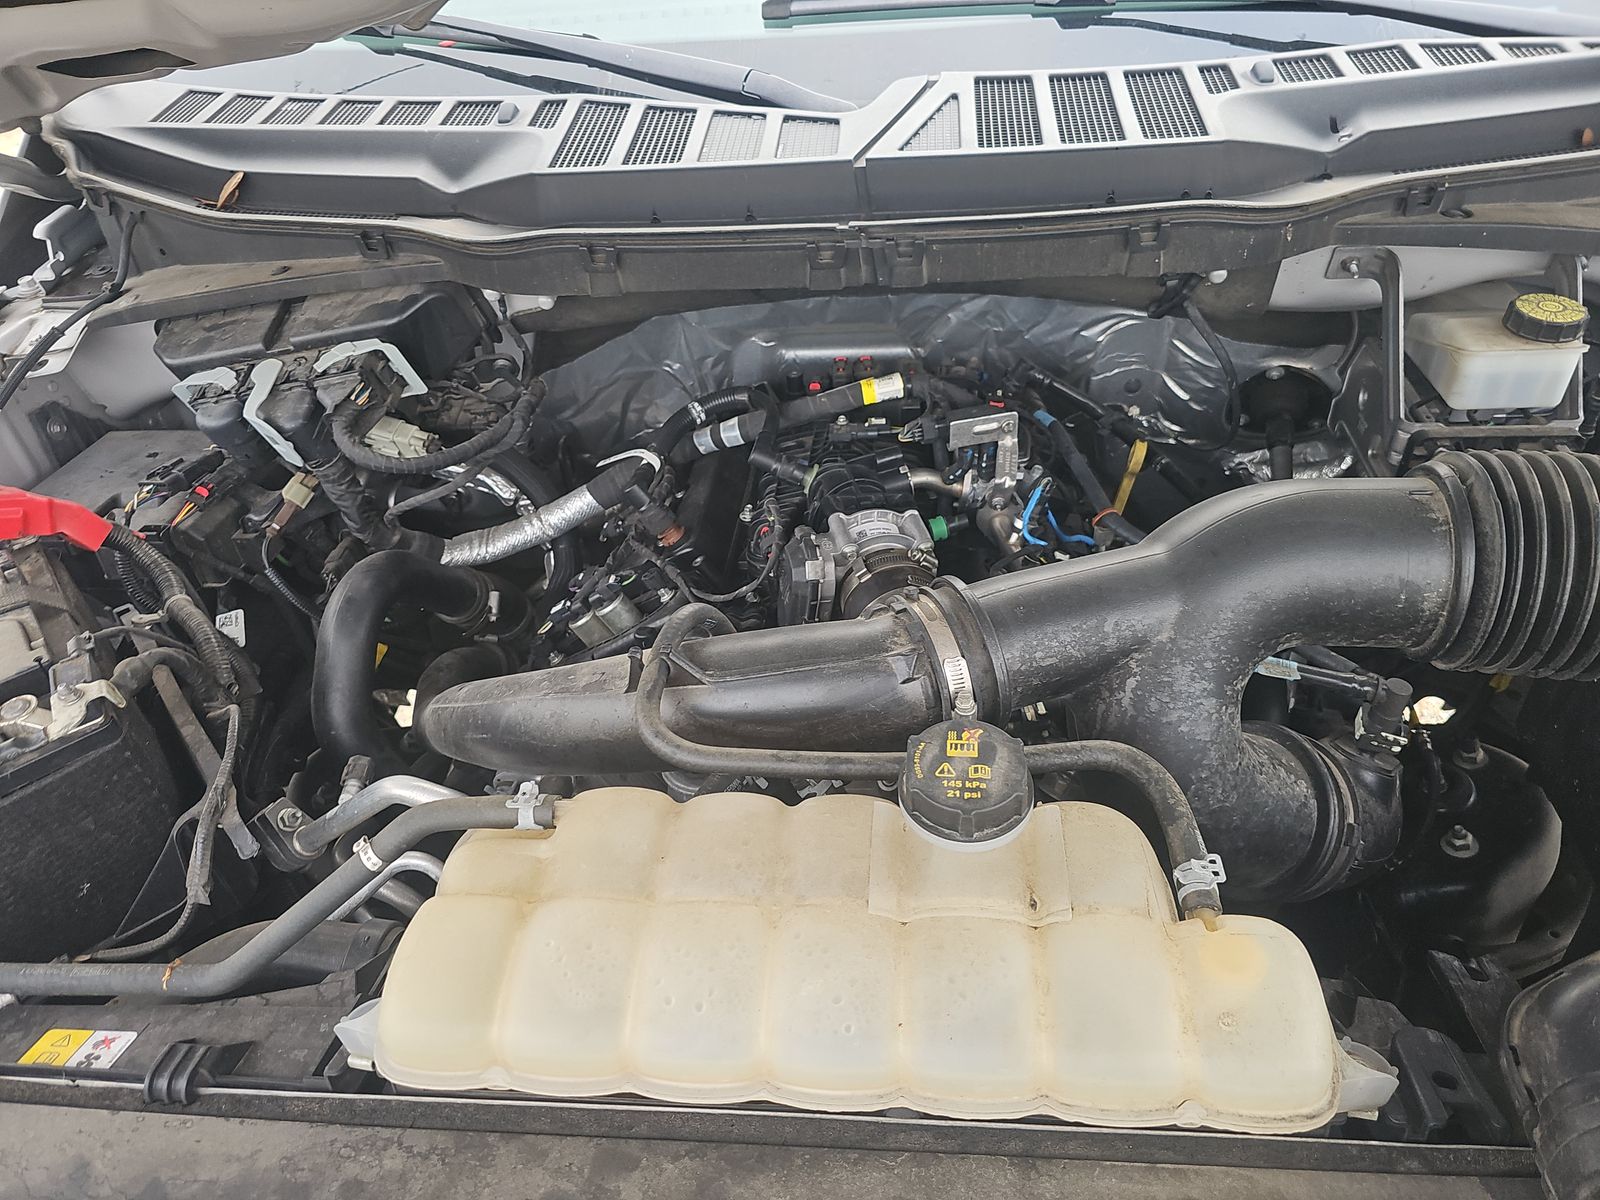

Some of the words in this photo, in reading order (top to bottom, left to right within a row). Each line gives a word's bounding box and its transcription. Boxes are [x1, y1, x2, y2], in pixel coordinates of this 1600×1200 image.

[941, 780, 962, 788] 145
[965, 780, 987, 789] kPa
[946, 790, 960, 798] 21
[963, 790, 981, 799] psi
